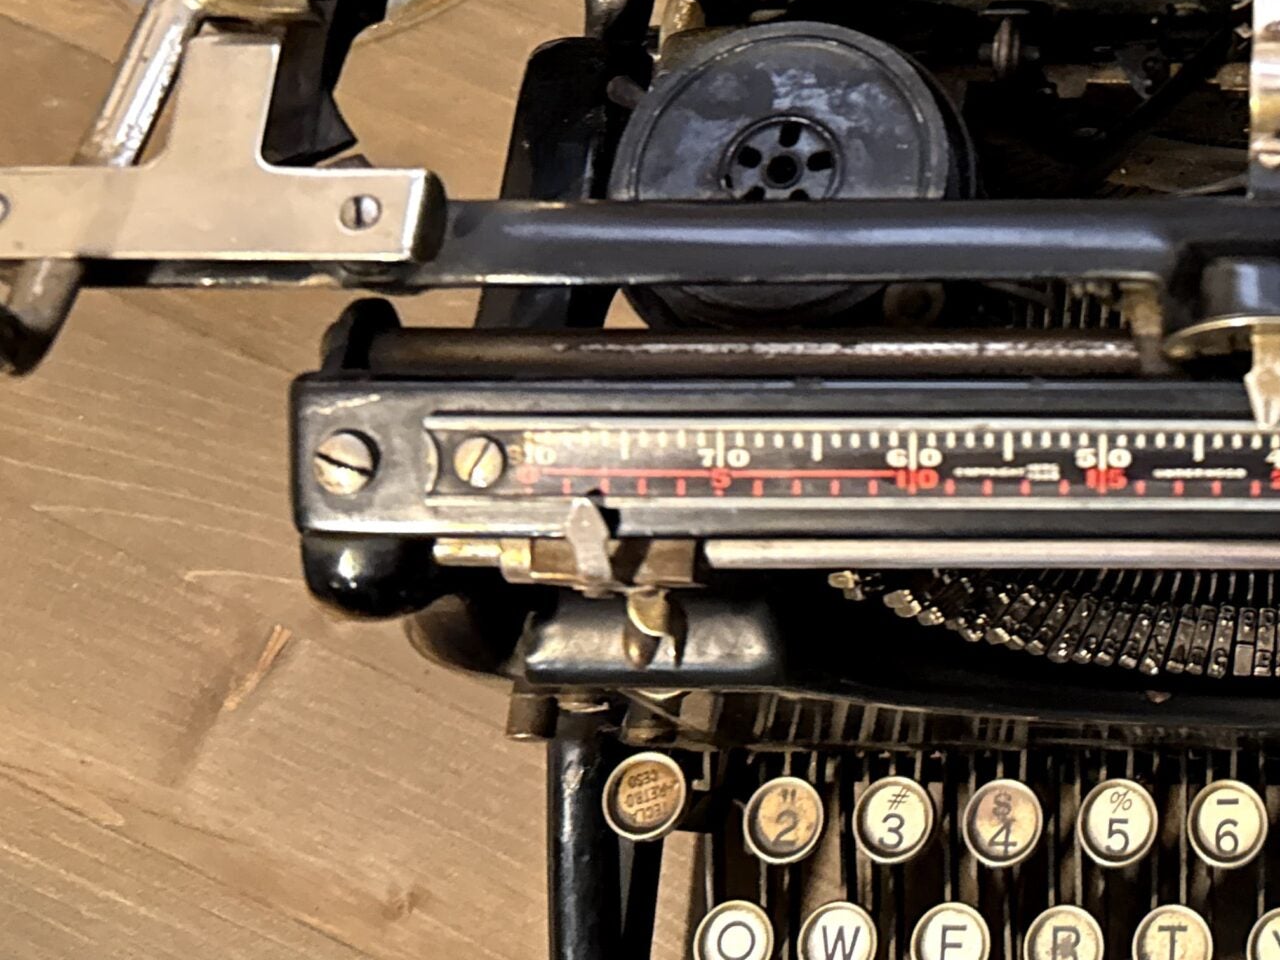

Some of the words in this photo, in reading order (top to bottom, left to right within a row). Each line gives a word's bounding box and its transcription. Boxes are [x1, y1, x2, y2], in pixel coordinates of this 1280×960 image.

[700, 448, 750, 468] 70
[886, 448, 943, 468] 60
[1075, 448, 1132, 469] 50
[772, 808, 801, 848] 2
[881, 812, 906, 850] 3
[988, 818, 1018, 857] 4
[1104, 817, 1131, 855] 5
[1214, 818, 1240, 856] 6
[821, 925, 862, 960] W
[1157, 924, 1188, 960] T
